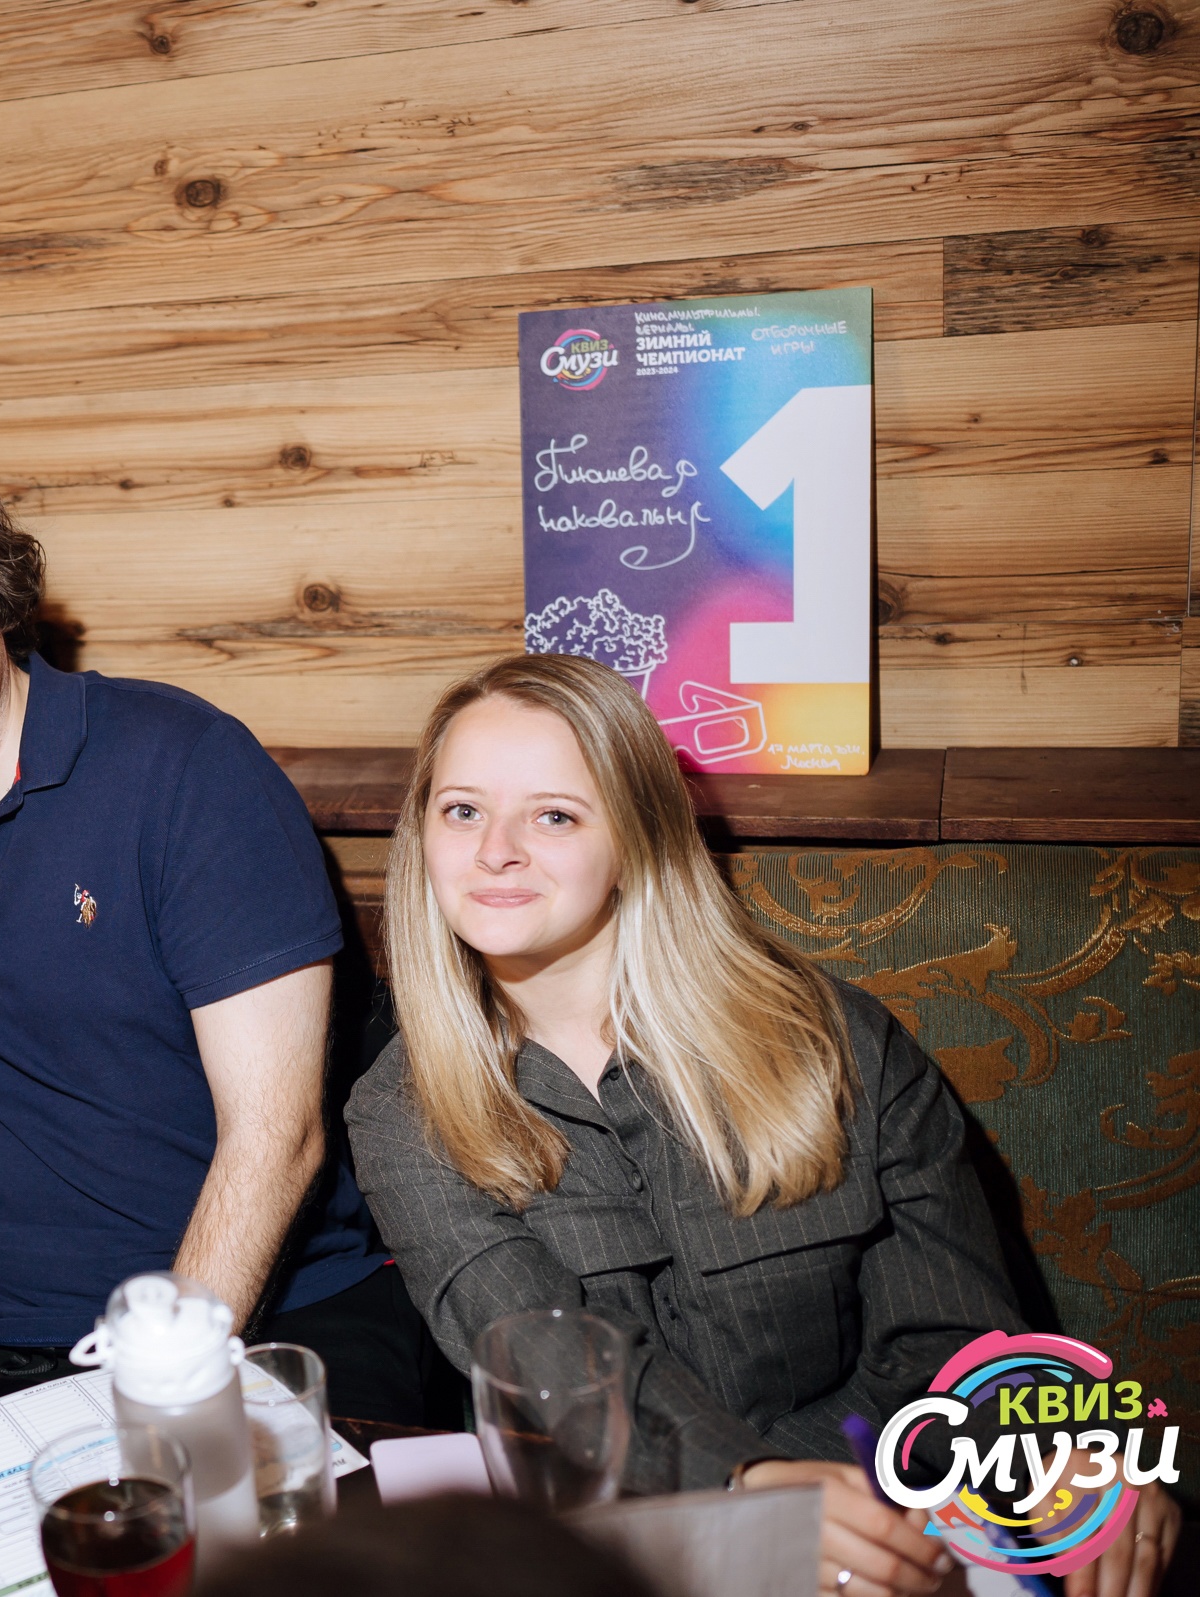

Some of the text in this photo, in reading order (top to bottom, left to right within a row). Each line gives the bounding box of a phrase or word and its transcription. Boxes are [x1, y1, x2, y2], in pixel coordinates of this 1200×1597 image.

[571, 338, 609, 353] КВИЗ
[636, 330, 712, 350] ЗИМНИЙ
[770, 340, 816, 355] ИГРЫ
[636, 347, 746, 366] ЧЕМПИОНАТ
[787, 743, 832, 755] МАРТА
